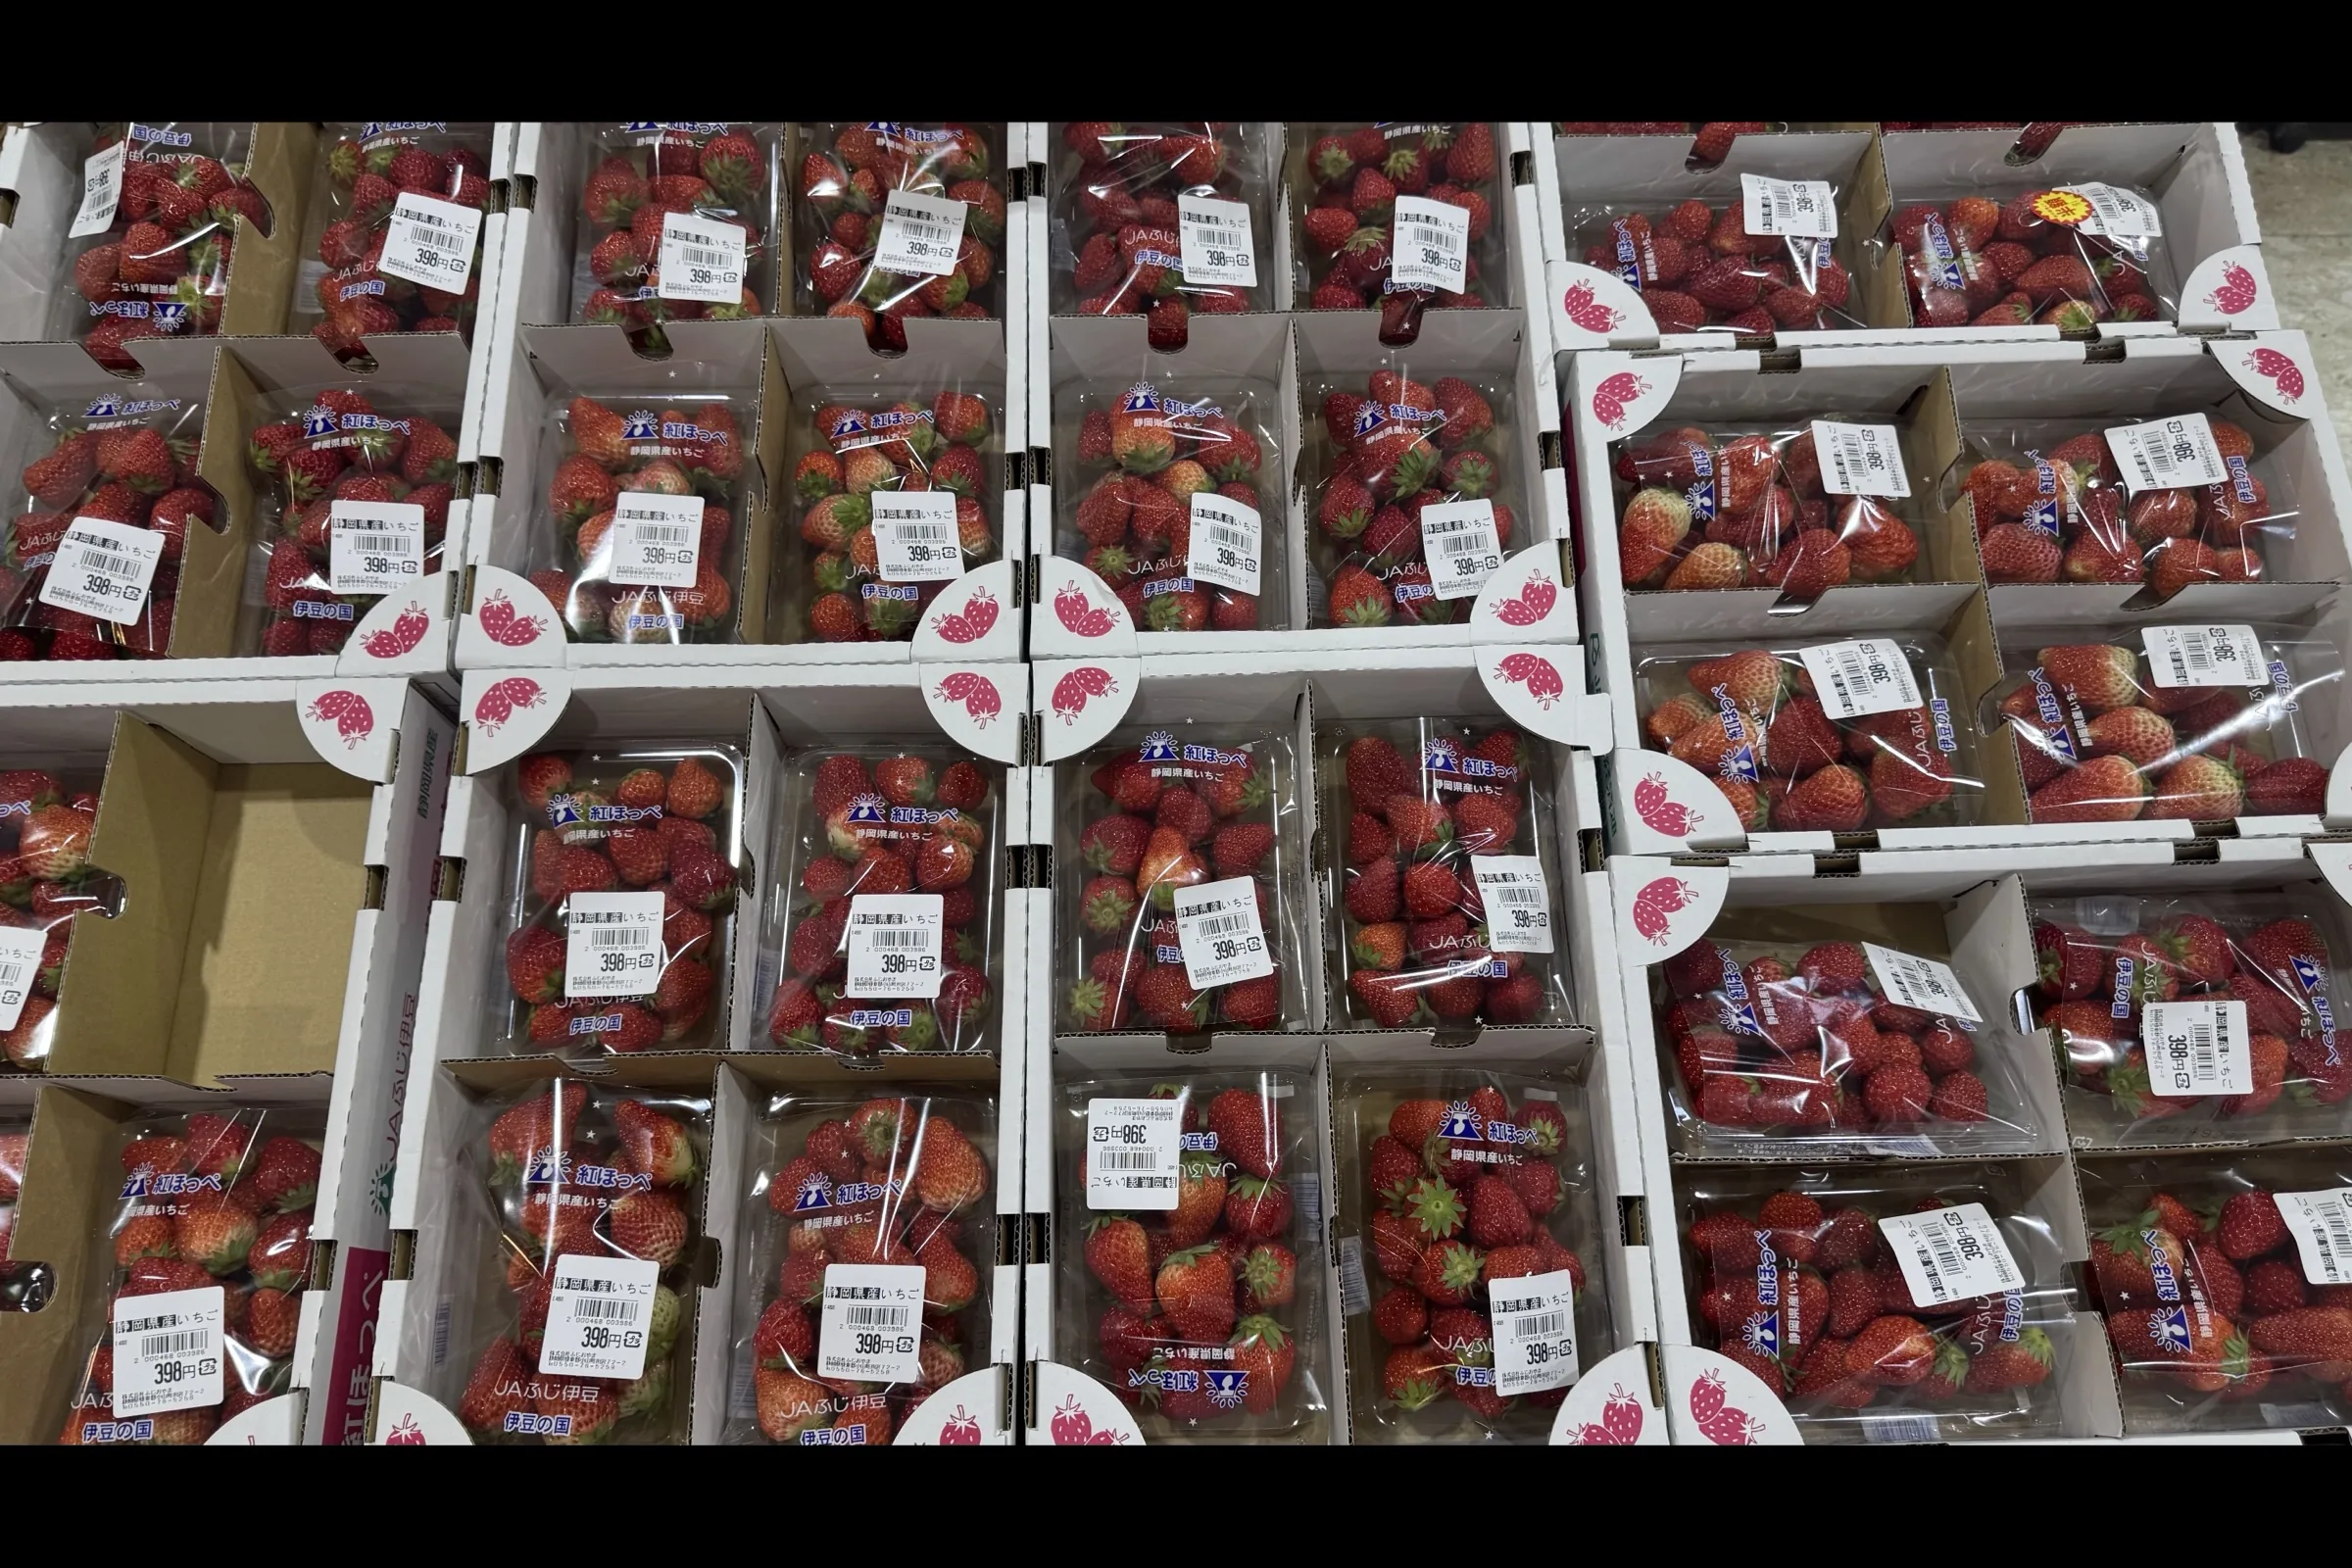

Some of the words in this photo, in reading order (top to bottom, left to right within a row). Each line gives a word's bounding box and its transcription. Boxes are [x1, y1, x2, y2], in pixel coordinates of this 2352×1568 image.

[133, 124, 192, 147] 伊豆の国
[905, 128, 964, 142] 紅ほっぺ
[1384, 124, 1451, 139] 静岡県産いちご
[1797, 192, 1814, 213] 398円
[394, 206, 475, 235] 静岡県産いちご
[886, 205, 962, 226] 静岡県産いちご
[1125, 229, 1181, 245] JAふじ
[1613, 219, 1636, 262] 紅ほっぺ
[1924, 213, 1953, 259] 紅ほっぺ
[415, 247, 449, 270] 398円
[906, 241, 938, 257] 398円
[1206, 250, 1236, 268] 398円
[1421, 247, 1448, 270] 398円
[332, 261, 381, 282] JAふじ
[690, 268, 721, 284] 398円
[340, 279, 385, 301] 伊豆の国
[90, 300, 149, 318] 紅ほっぺ
[122, 399, 180, 416] 紅ほっぺ
[1164, 398, 1224, 418] 紅ほっぺ
[1390, 403, 1446, 421] 紅ほっぺ
[86, 416, 151, 431] 静岡県産いちご
[341, 415, 412, 435] 紅ほっぺ
[870, 410, 934, 428] 紅ほっぺ
[312, 436, 384, 451] 静岡県産いちご
[662, 422, 728, 446] 紅ほっぺ
[1365, 425, 1430, 445] 静岡県産いちご
[630, 445, 705, 458] 静岡県産いちご
[1866, 443, 1885, 470] 398円
[2173, 433, 2195, 464] 398円
[2024, 449, 2057, 495] 紅ほっぺ
[2228, 457, 2256, 504] 伊豆の国
[333, 517, 419, 532] 静岡県産いちご
[874, 509, 953, 520] 静岡県産いちご
[1192, 508, 1259, 534] 静岡県産いちご
[1423, 516, 1491, 536] 静岡県産いちご
[20, 530, 67, 551] JAふじ
[66, 530, 157, 560] 静岡県産いちご
[24, 552, 55, 572] 伊豆の
[642, 546, 676, 564] 398円
[908, 545, 941, 562] 398円
[1217, 547, 1244, 570] 398円
[364, 557, 400, 574] 398円
[1376, 563, 1427, 581] JAふじ
[1454, 558, 1486, 576] 398円
[82, 574, 122, 598] 398円
[861, 584, 919, 601] 伊豆の国
[1144, 577, 1194, 597] 伊豆の国
[1396, 586, 1433, 603] 伊豆の
[294, 601, 354, 621] 伊豆の国
[2215, 637, 2236, 662] 398円
[1867, 654, 1891, 683] 398円
[2028, 666, 2062, 723] 紅ほっぺ
[1711, 683, 1744, 740] 紅ほっぺ
[2062, 683, 2093, 747] 静岡県産いちご
[1930, 698, 1957, 752] 伊豆の国
[1184, 745, 1247, 768] 紅ほっぺ
[1152, 767, 1224, 782] 静岡県産いちご
[1462, 758, 1518, 782] 紅ほっぺ
[1434, 778, 1503, 797] 静岡県産いちご
[588, 805, 663, 821] 紅ほっぺ
[890, 806, 958, 823] 紅ほっぺ
[855, 828, 933, 841] 静岡県産いちご
[1177, 894, 1252, 917] 静岡県産いちご
[570, 910, 660, 924] 静岡県産いちご
[853, 913, 937, 924] 静岡県産いちご
[1513, 909, 1538, 928] 398円
[1214, 940, 1247, 960] 398円
[1429, 934, 1491, 950] JAふじ
[601, 954, 637, 972] 398円
[882, 955, 917, 973] 398円
[1715, 947, 1748, 1002] 紅ほっぺ
[1922, 970, 1947, 998] 398円
[2111, 956, 2133, 1019] 伊豆の国
[569, 1014, 622, 1036] 伊豆の国
[850, 1009, 911, 1026] 伊豆の国
[2312, 996, 2341, 1066] 紅ほっぺ
[2168, 1035, 2189, 1071] 398円
[2214, 1002, 2234, 1089] 静岡県産いちご
[385, 992, 416, 1163] JAふじ伊豆
[1110, 1124, 1147, 1144] 398円
[1487, 1120, 1540, 1146] 紅ほっぺ
[1450, 1148, 1524, 1167] 静岡県産いちご
[152, 1173, 222, 1196] 紅ほっぺ
[575, 1165, 653, 1190] 紅ほっぺ
[1091, 1176, 1178, 1189] 静岡県産いちご
[535, 1193, 621, 1210] 静岡県産いちご
[836, 1179, 902, 1204] 紅ほっぺ
[804, 1210, 874, 1232] 静岡県産いちご
[1956, 1226, 1984, 1261] 398円
[2293, 1197, 2339, 1282] 静岡県産いちご
[1754, 1230, 1779, 1306] 紅ほっぺ
[1899, 1219, 1948, 1303] 静岡県産いちご
[2140, 1230, 2180, 1301] 紅ほっぺ
[555, 1276, 652, 1296] 静岡県産いちご
[825, 1285, 920, 1301] 静岡県産いちご
[2179, 1253, 2213, 1338] 静岡県産いちご
[1493, 1291, 1570, 1314] 静岡県産いちご
[1787, 1257, 1800, 1346] 静岡県産いちご
[116, 1308, 219, 1336] 静岡県産いちご
[1970, 1295, 1991, 1355] JAふじ
[580, 1327, 621, 1348] 398円
[856, 1333, 894, 1354] 398円
[1152, 1348, 1237, 1361] 静岡県産いちご
[1526, 1344, 1559, 1366] 398円
[154, 1360, 196, 1385] 398円
[1128, 1369, 1200, 1392] 紅ほっぺ
[494, 1381, 600, 1403] JAふじ伊豆
[780, 1391, 887, 1418] JAふじ伊豆
[82, 1420, 153, 1443] 伊豆の国
[504, 1412, 571, 1436] 伊豆の国
[800, 1424, 866, 1446] 伊豆の国
